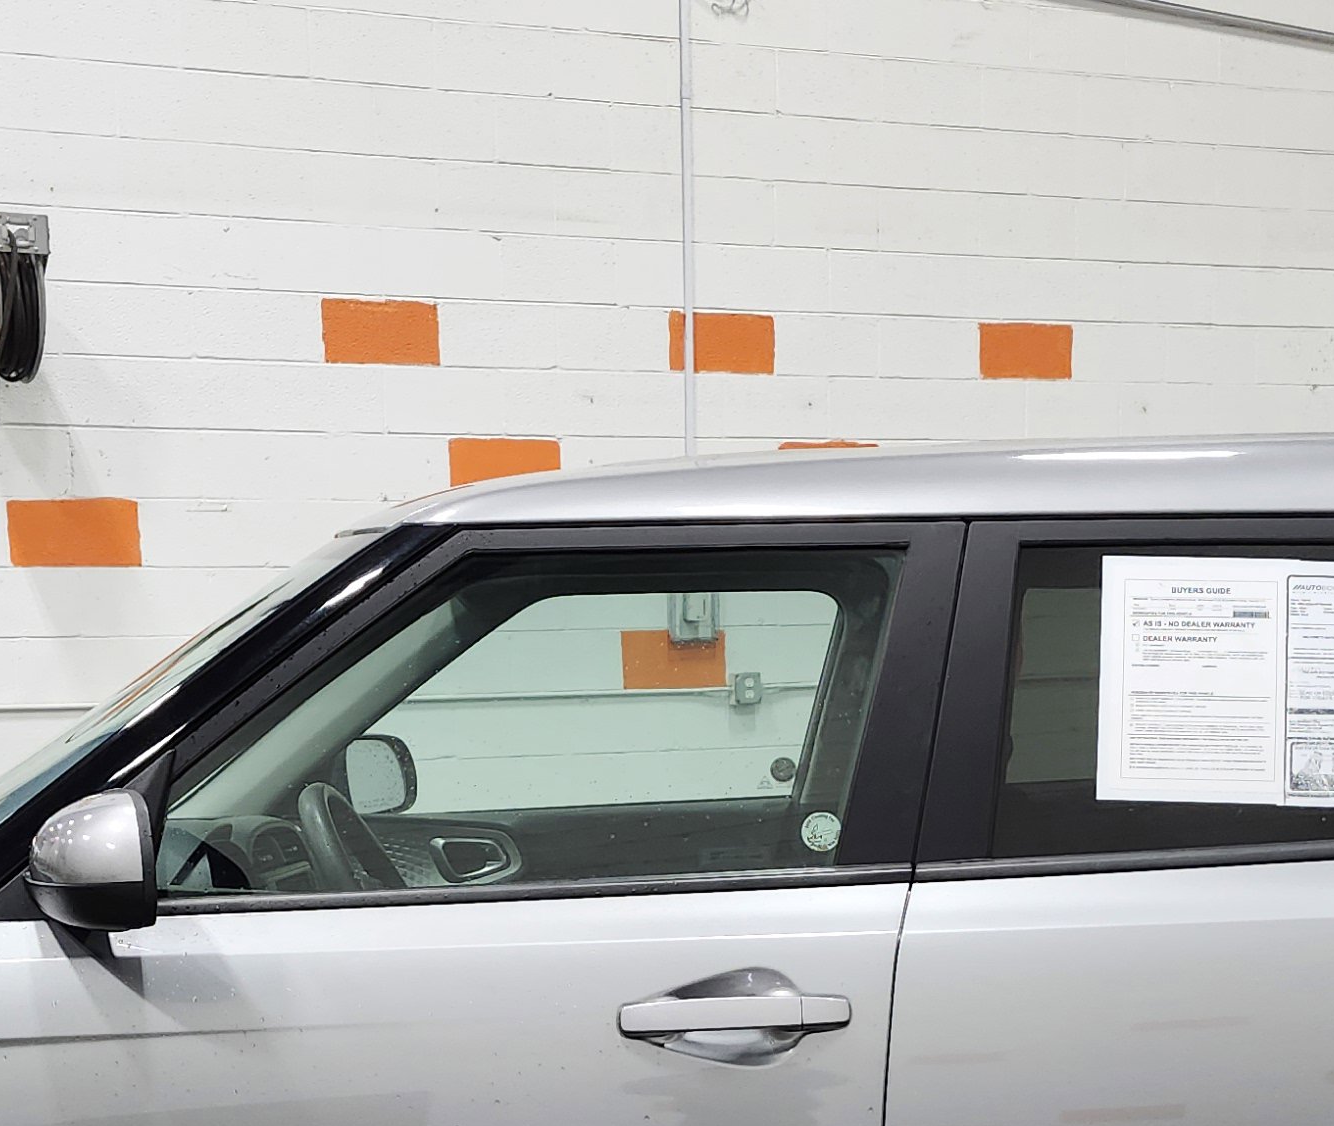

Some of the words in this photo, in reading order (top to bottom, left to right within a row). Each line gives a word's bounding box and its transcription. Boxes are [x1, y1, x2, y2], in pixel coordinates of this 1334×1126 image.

[1171, 586, 1204, 594] BUYERS
[1206, 587, 1231, 595] GUIDE
[1168, 620, 1179, 628] NO
[1213, 621, 1255, 629] WARRANTY
